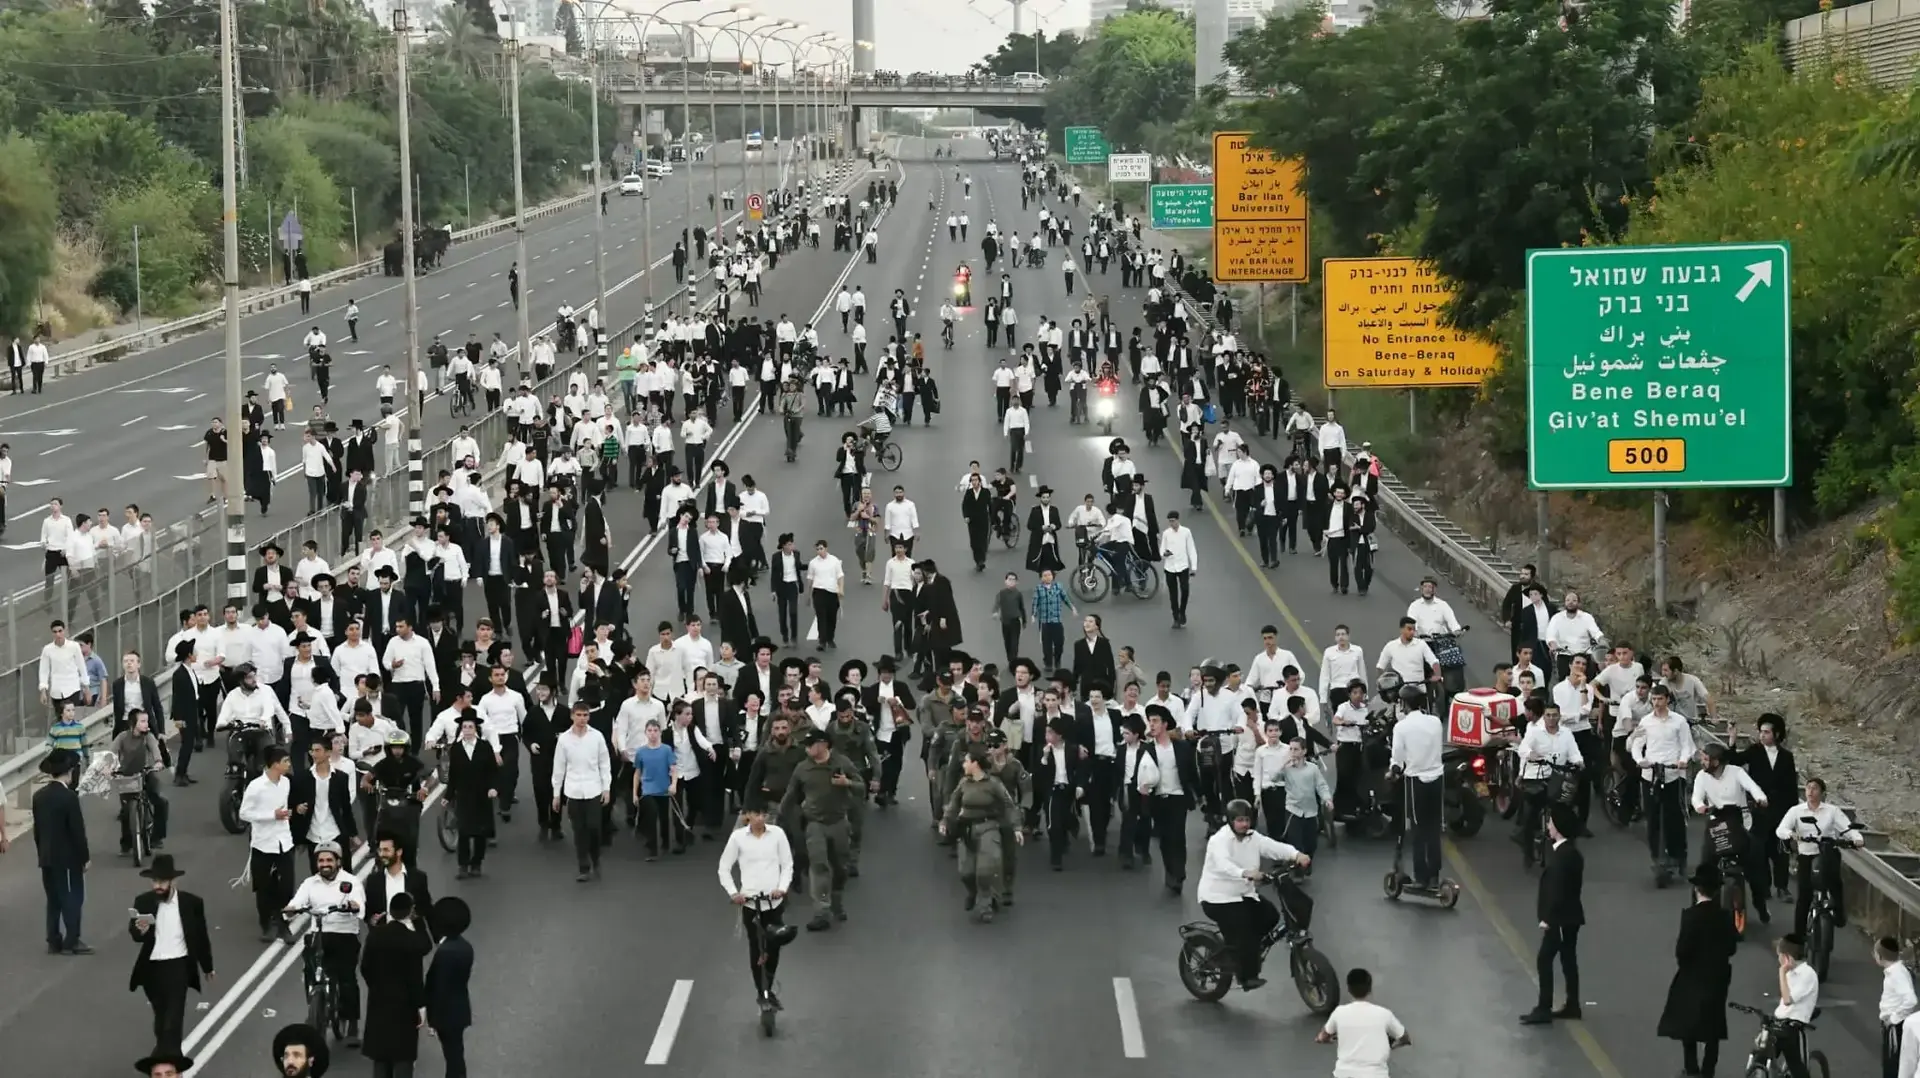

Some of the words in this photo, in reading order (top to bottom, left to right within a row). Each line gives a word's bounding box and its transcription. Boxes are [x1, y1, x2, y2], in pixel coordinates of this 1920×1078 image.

[1241, 153, 1264, 164] אילן
[1239, 192, 1258, 201] Bar
[1263, 192, 1284, 201] Ilan
[1231, 204, 1290, 214] University
[1229, 257, 1245, 266] VIA
[1249, 257, 1268, 265] BAR
[1272, 256, 1294, 265] ILAN
[1228, 267, 1295, 276] INTERCHANGE
[1569, 265, 1647, 287] שמואל
[1661, 264, 1721, 285] גבעת
[1370, 284, 1403, 295] וחגים
[1599, 295, 1642, 317] ברק
[1655, 294, 1690, 313] בני
[1362, 335, 1379, 345] No
[1387, 333, 1446, 344] Entrance
[1454, 333, 1467, 342] to
[1599, 324, 1646, 348] براك
[1659, 325, 1691, 349] بني
[1375, 350, 1455, 361] Bene-Beraq
[1334, 370, 1350, 379] on
[1357, 367, 1416, 380] Saturday
[1423, 366, 1433, 377] &
[1563, 352, 1645, 379] شموئيل
[1571, 383, 1634, 401] Bene
[1646, 381, 1721, 403] Beraq
[1548, 410, 1620, 430] Giv'at
[1633, 408, 1747, 428] Shemu'el
[1624, 446, 1669, 465] 500
